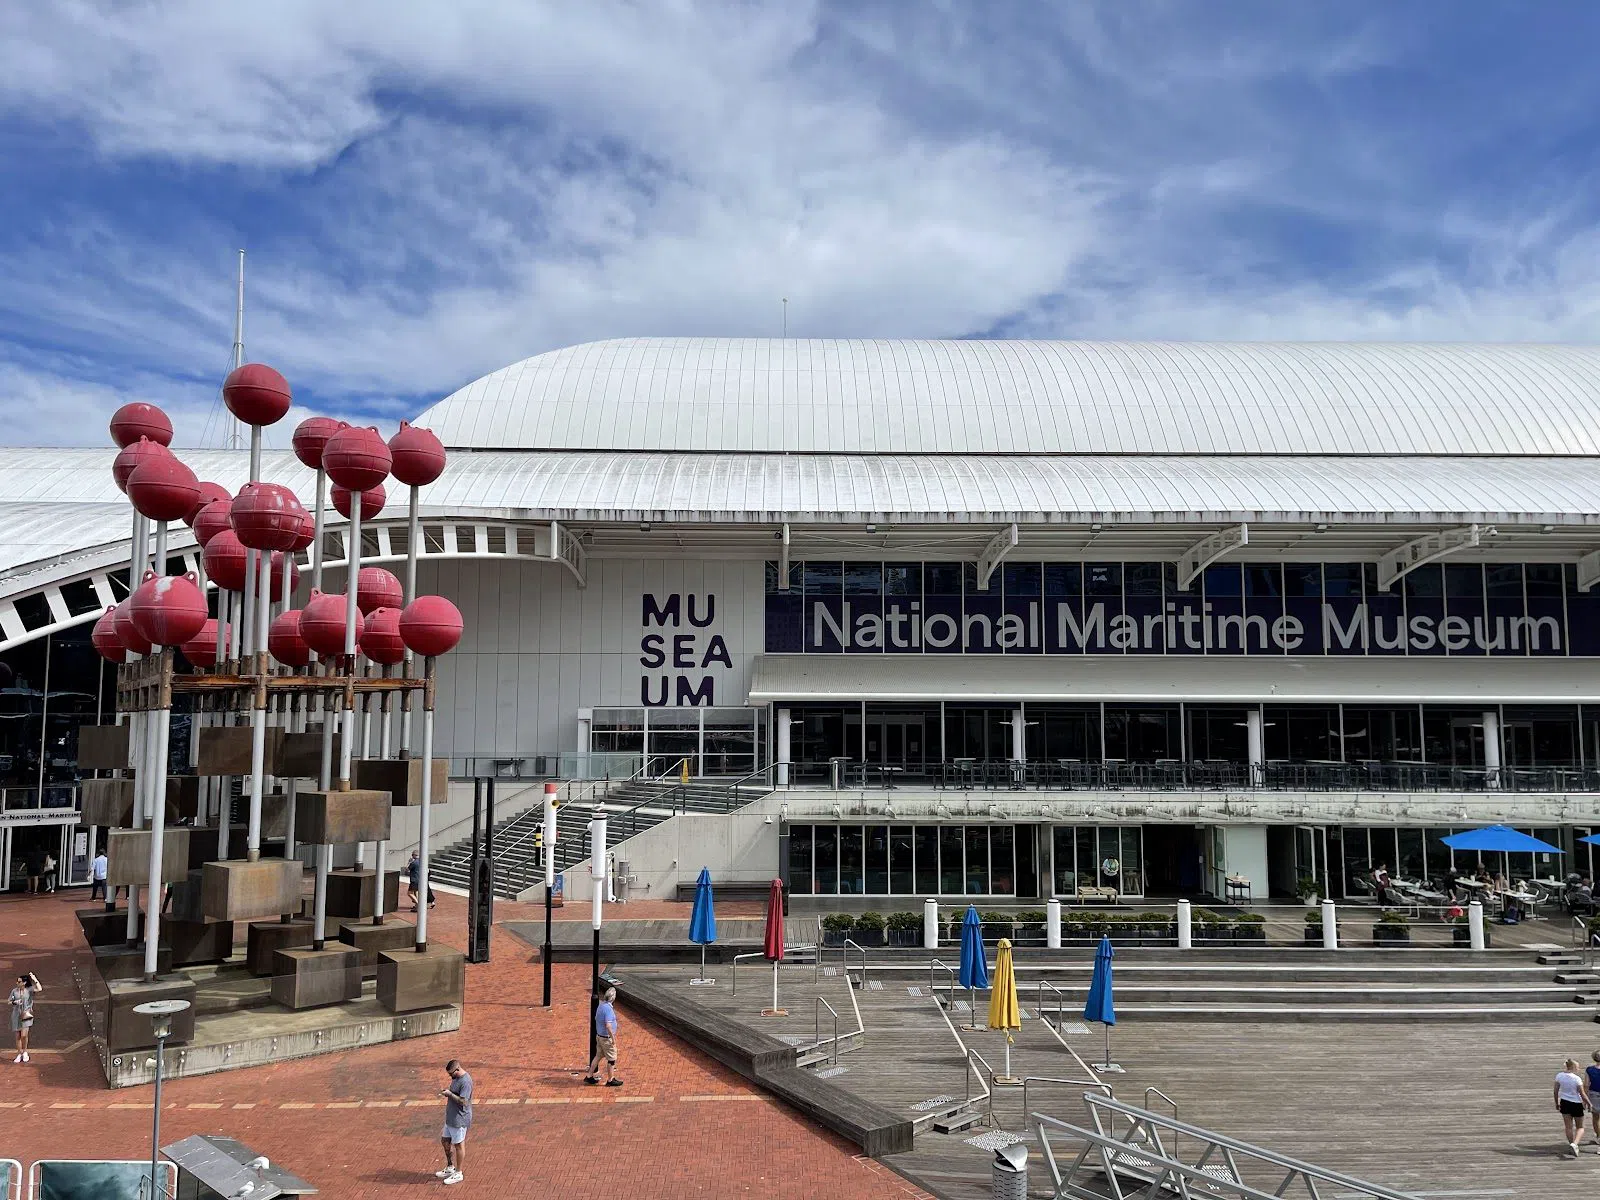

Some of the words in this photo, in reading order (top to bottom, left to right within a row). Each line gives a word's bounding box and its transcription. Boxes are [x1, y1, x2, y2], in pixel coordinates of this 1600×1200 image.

[642, 593, 715, 628] MU
[813, 601, 1039, 649] National
[1057, 602, 1305, 649] Maritime
[1321, 603, 1561, 650] Museum
[640, 634, 733, 668] SEA
[641, 675, 714, 706] UM
